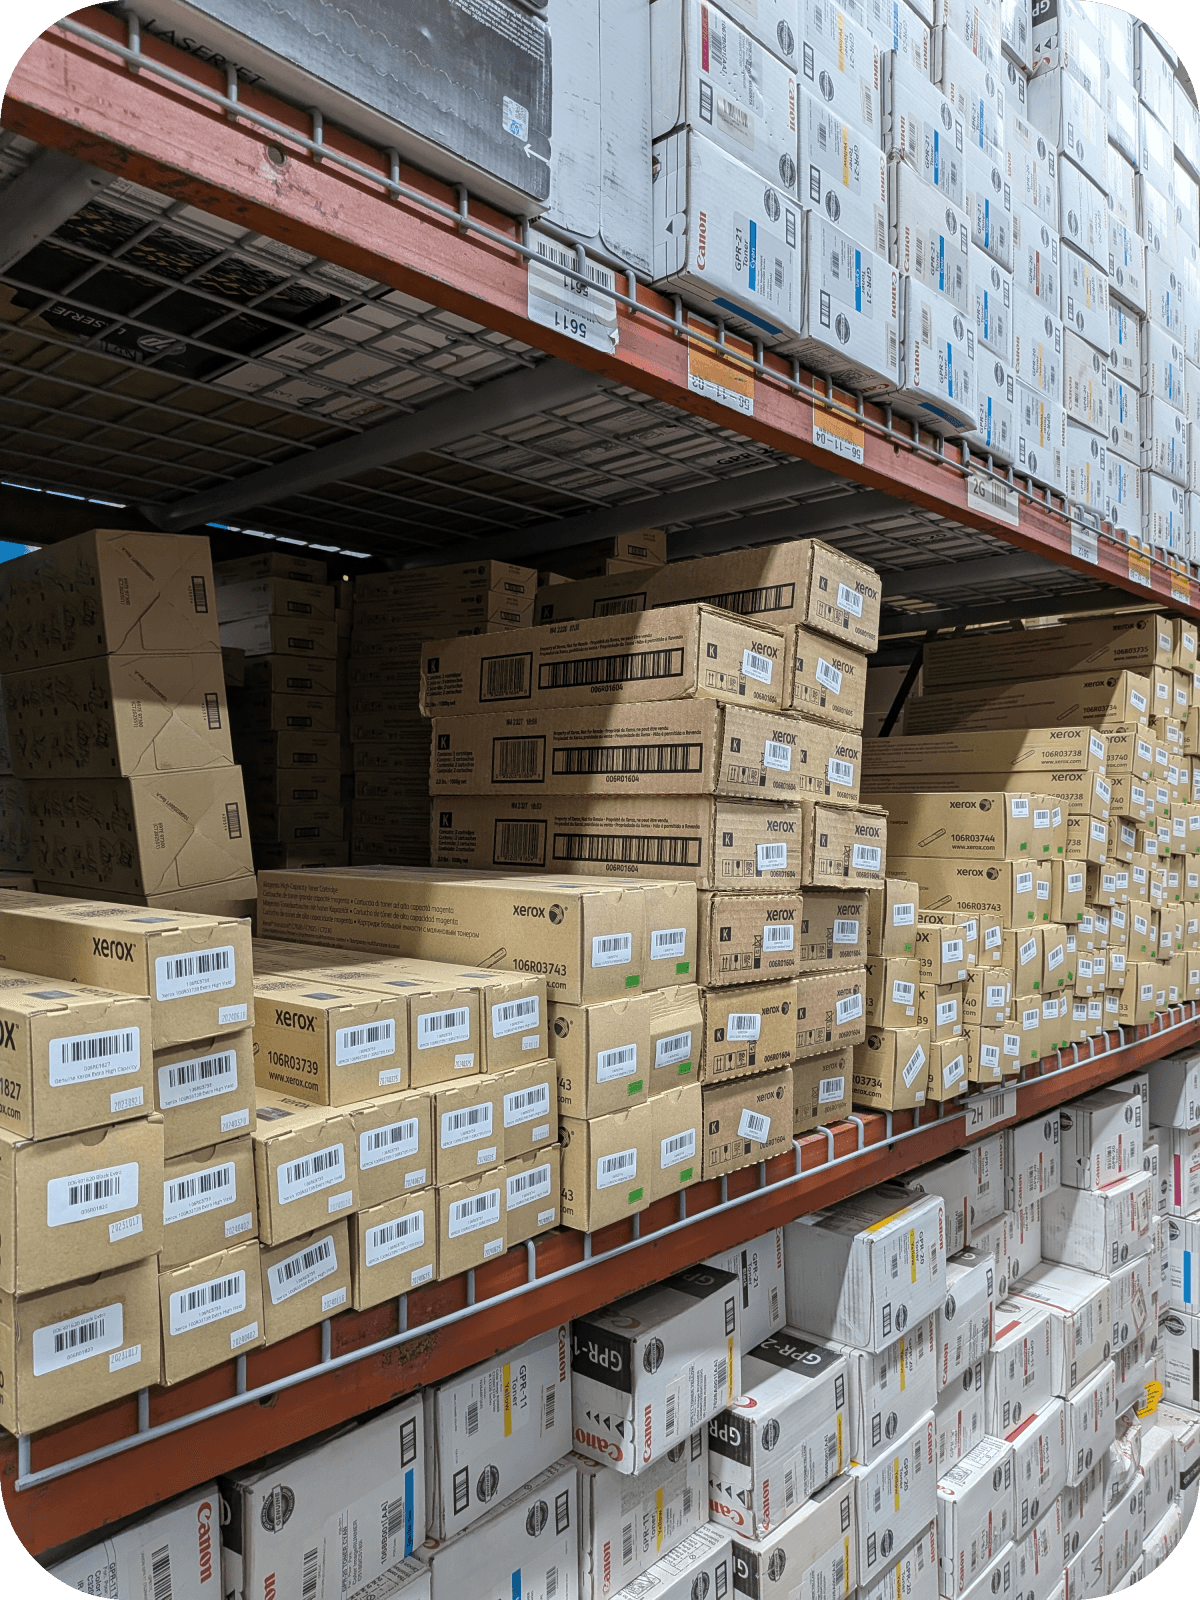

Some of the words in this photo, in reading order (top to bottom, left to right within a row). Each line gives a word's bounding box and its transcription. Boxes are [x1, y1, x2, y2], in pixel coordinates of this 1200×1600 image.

[788, 78, 796, 132] Canon
[697, 211, 707, 271] Canon
[554, 311, 587, 339] 5611
[816, 430, 861, 460] 56-11-04
[973, 478, 986, 498] 2G
[855, 580, 877, 600] xerox
[751, 640, 778, 658] xerox
[832, 658, 854, 675] xerox
[590, 684, 623, 693] 006R01604
[1083, 680, 1105, 688] xerox
[772, 730, 796, 745] xerox
[1049, 730, 1081, 740] xerox
[835, 745, 858, 761] xerox
[1041, 750, 1082, 758] 106R03738
[605, 775, 639, 783] 006R01604
[1050, 772, 1083, 782] xerox
[949, 801, 977, 809] xerox
[766, 819, 794, 833] xerox
[854, 824, 879, 838] xerox
[951, 834, 995, 843] 106R03744
[605, 864, 639, 872] 006R01604
[956, 868, 984, 877] xerox
[431, 905, 454, 914] magenta
[512, 904, 545, 919] xerox
[837, 905, 860, 916] xerox
[956, 901, 1001, 912] 106R03743
[436, 915, 458, 925] magenta
[766, 910, 794, 922] xerox
[93, 937, 134, 962] xerox
[512, 958, 567, 976] 106R03743
[768, 959, 795, 968] 006R01604
[761, 1004, 780, 1015] xerox
[275, 1009, 315, 1032] xerox
[268, 1051, 319, 1076] 106R03739
[269, 1070, 319, 1092] www.xerox.com
[756, 1091, 775, 1103] xerox
[558, 1325, 566, 1383] Canon
[573, 1336, 623, 1372] GPR-1
[760, 1338, 822, 1365] GPR-2
[519, 1365, 527, 1410] GPR-11
[643, 1404, 651, 1463] Canon
[709, 1419, 741, 1447] GPR
[197, 1501, 213, 1584] Canon
[603, 1540, 611, 1596] Canon
